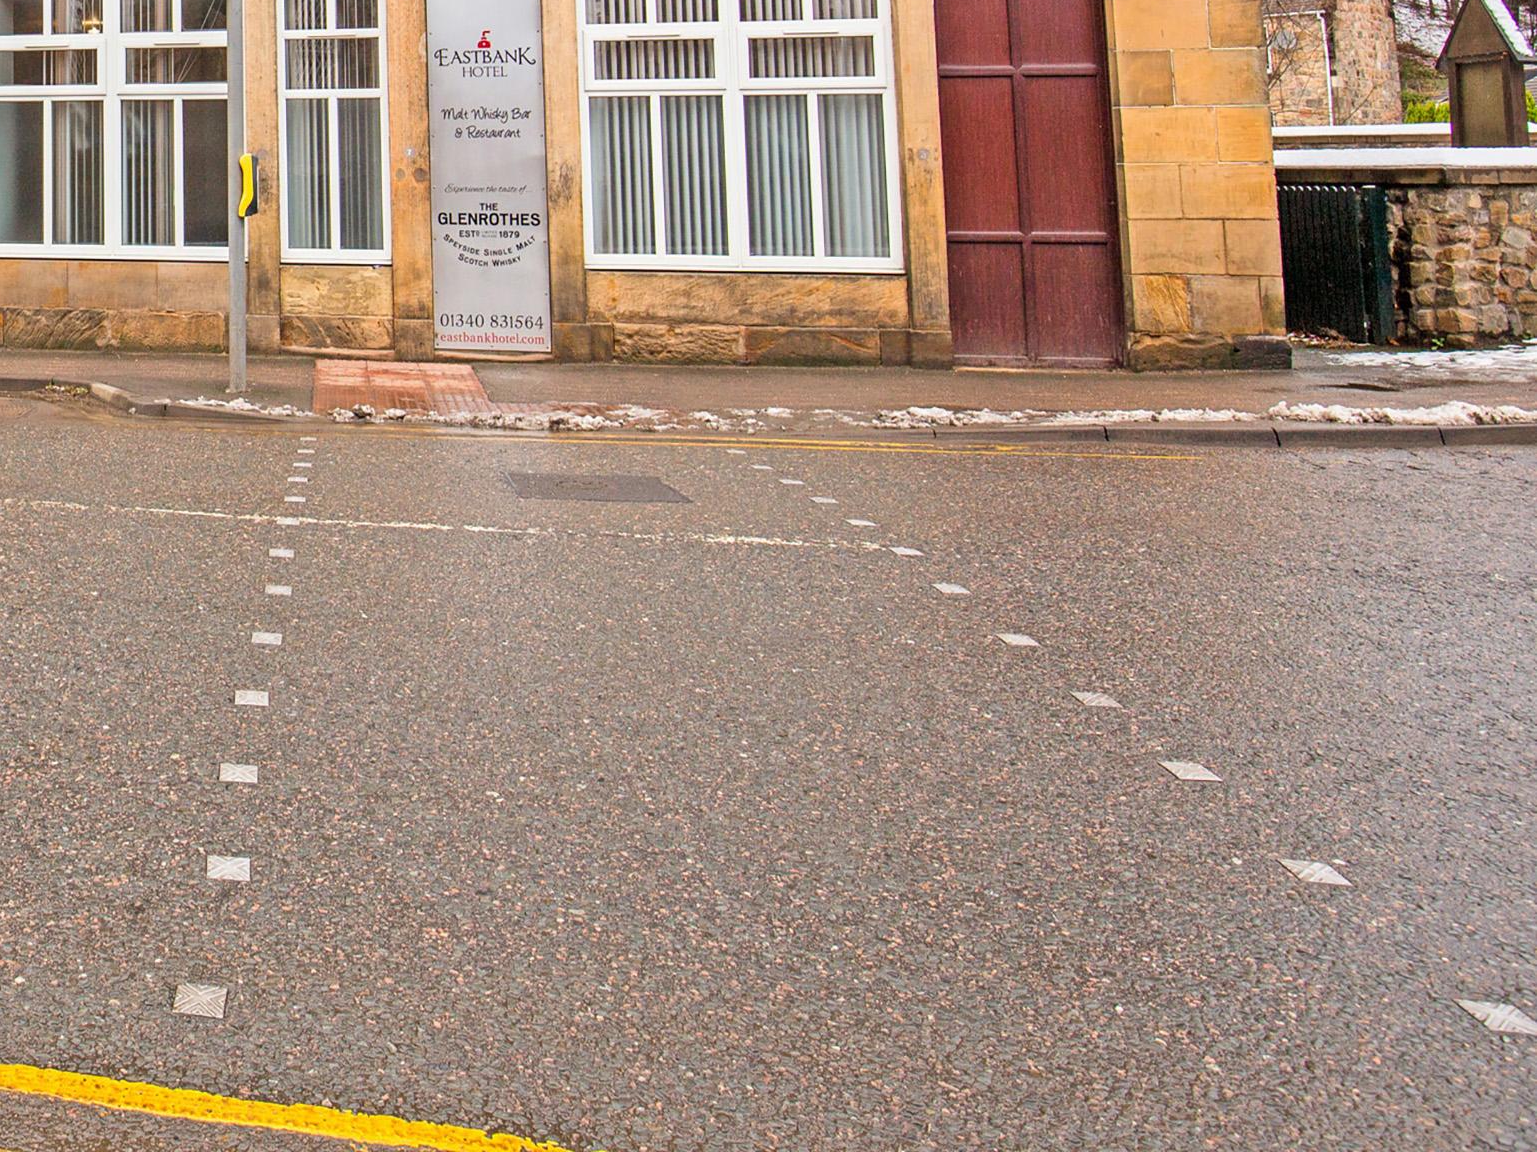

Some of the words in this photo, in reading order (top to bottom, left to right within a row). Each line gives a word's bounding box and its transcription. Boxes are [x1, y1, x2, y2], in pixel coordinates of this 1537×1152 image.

[434, 47, 537, 68] EASTBANK
[462, 65, 508, 78] HOTEL
[441, 107, 470, 122] Malt
[471, 106, 509, 124] Whisky
[511, 108, 533, 121] Bar
[454, 127, 465, 139] &
[466, 125, 521, 140] Restaurant
[444, 183, 484, 194] Experience
[485, 184, 497, 193] the
[498, 185, 517, 193] taste
[479, 202, 499, 212] THE
[438, 212, 541, 227] GLENROTHES
[499, 230, 520, 239] 1879
[440, 313, 485, 328] 01340
[490, 314, 545, 330] 831564
[440, 332, 546, 346] eastbankhotel.com
